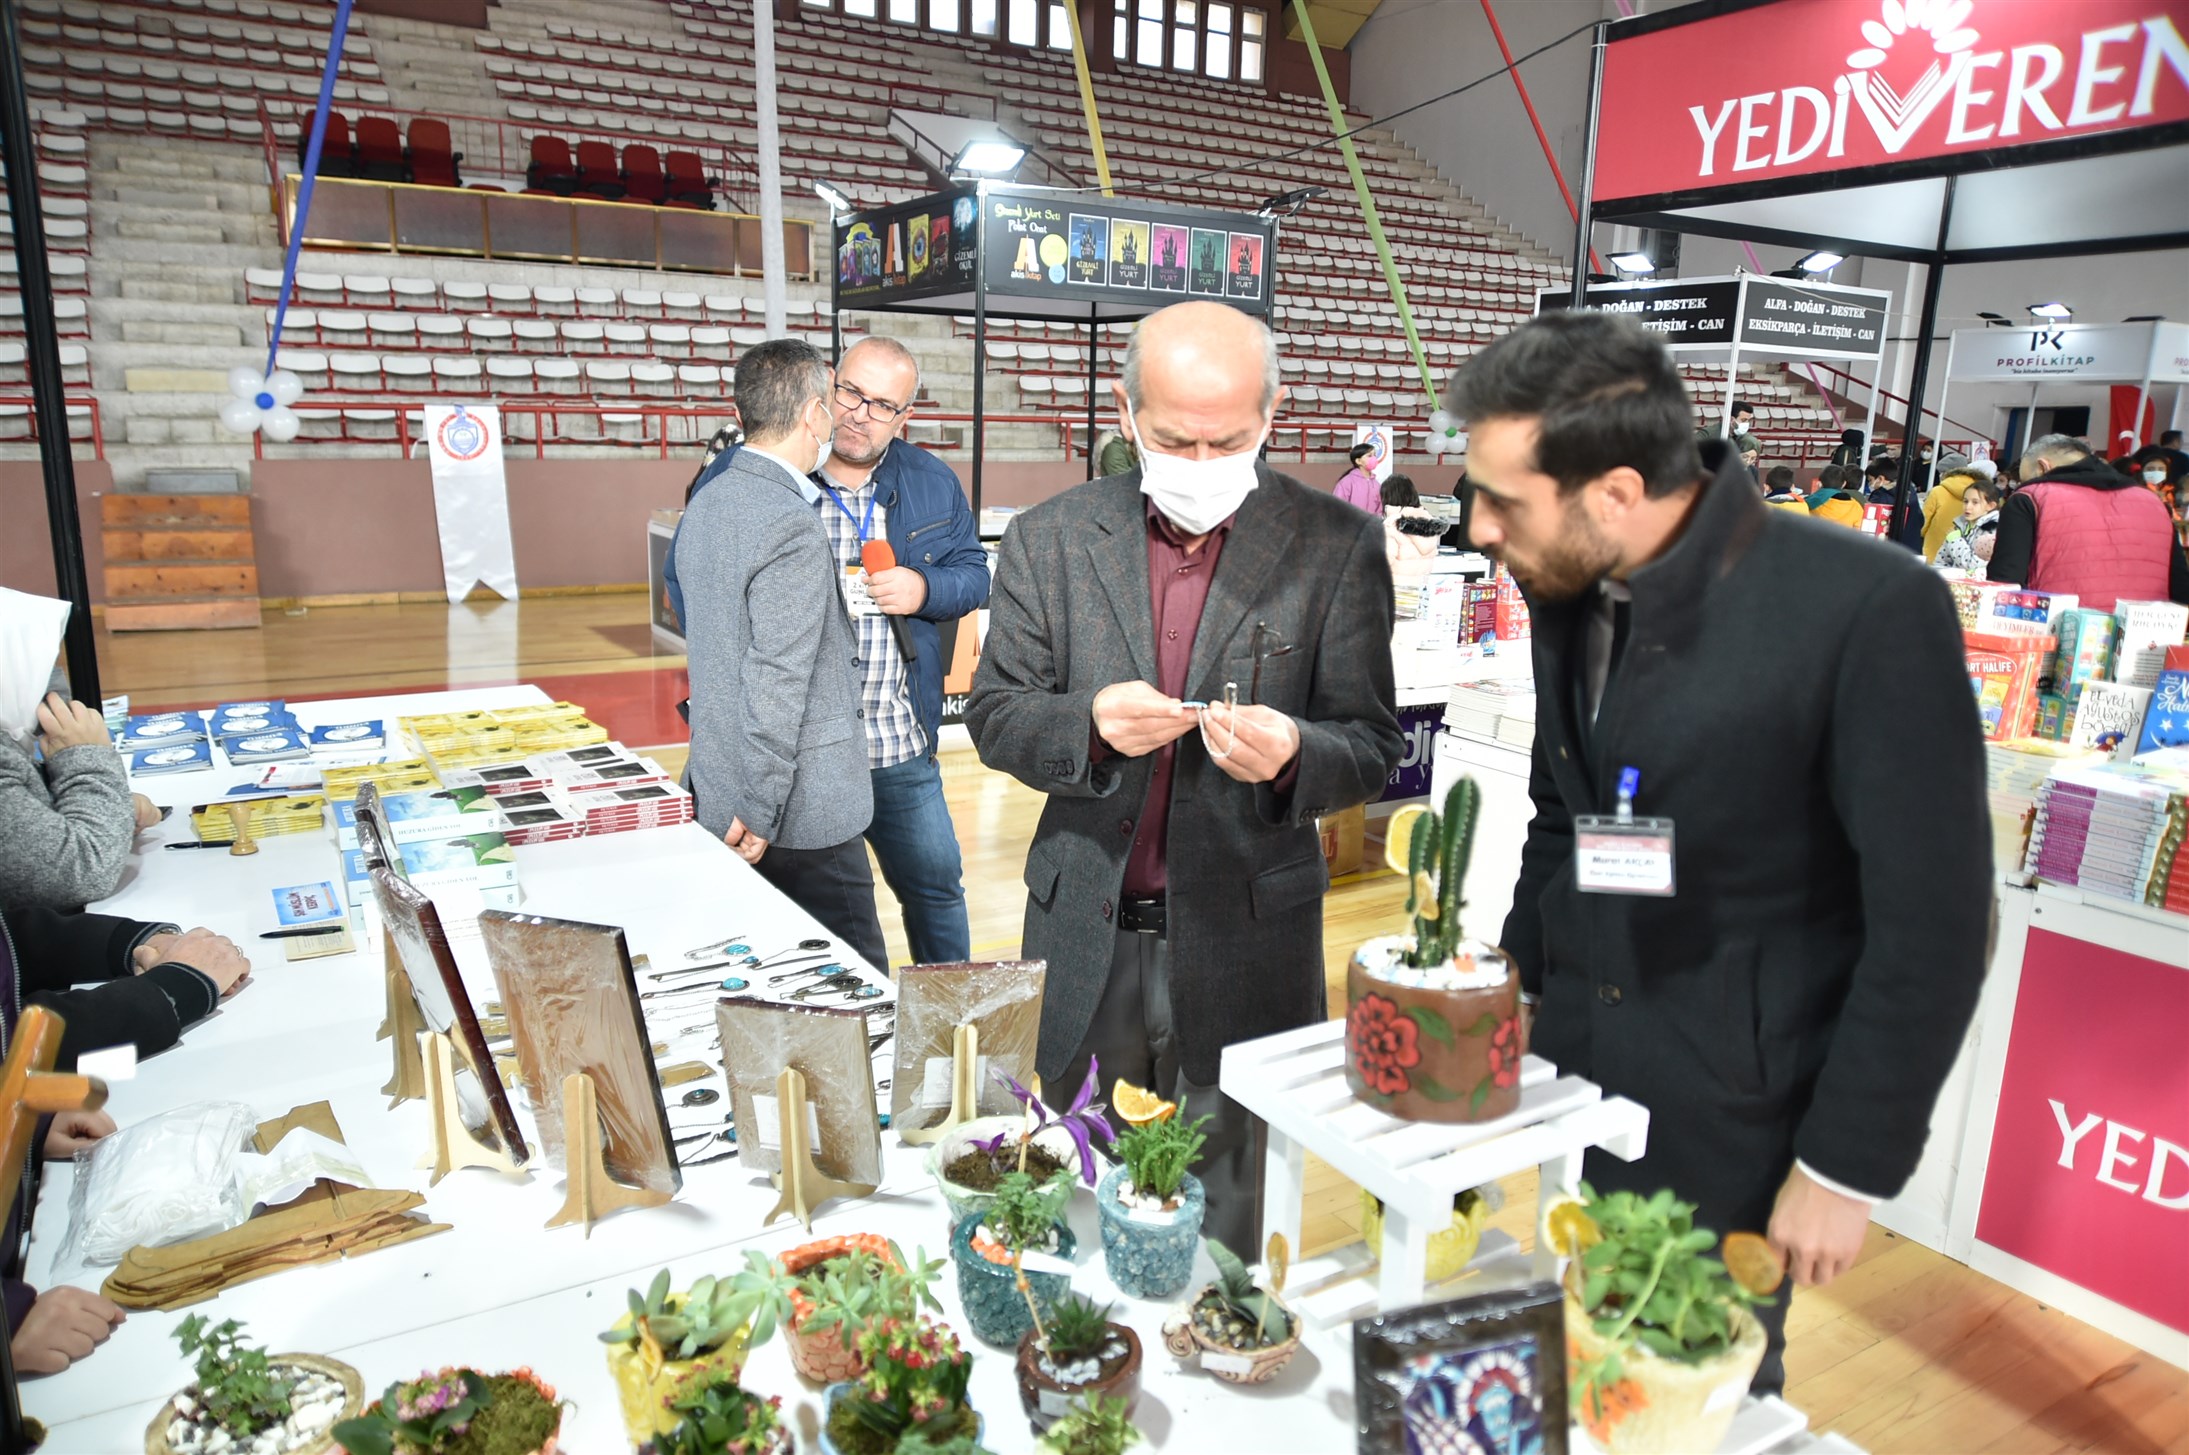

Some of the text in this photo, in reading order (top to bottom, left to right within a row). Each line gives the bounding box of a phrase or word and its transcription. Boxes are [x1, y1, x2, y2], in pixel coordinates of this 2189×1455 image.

[1022, 207, 1042, 221] Yurt
[1602, 299, 1645, 313] DOĞAN
[1653, 298, 1708, 312] DESTEK
[1764, 298, 1787, 311] ALFA
[1793, 299, 1826, 315] DOĞAN
[1831, 305, 1866, 319] DESTEK
[1698, 318, 1725, 330] CAN
[1748, 317, 1806, 336] EKSİKPARÇA
[1812, 322, 1852, 340] İLETİŞİM
[1857, 329, 1875, 341] CAN
[1966, 661, 1981, 672] RT
[942, 695, 970, 716] ki
[1398, 720, 1439, 768] di
[1416, 763, 1433, 790] y
